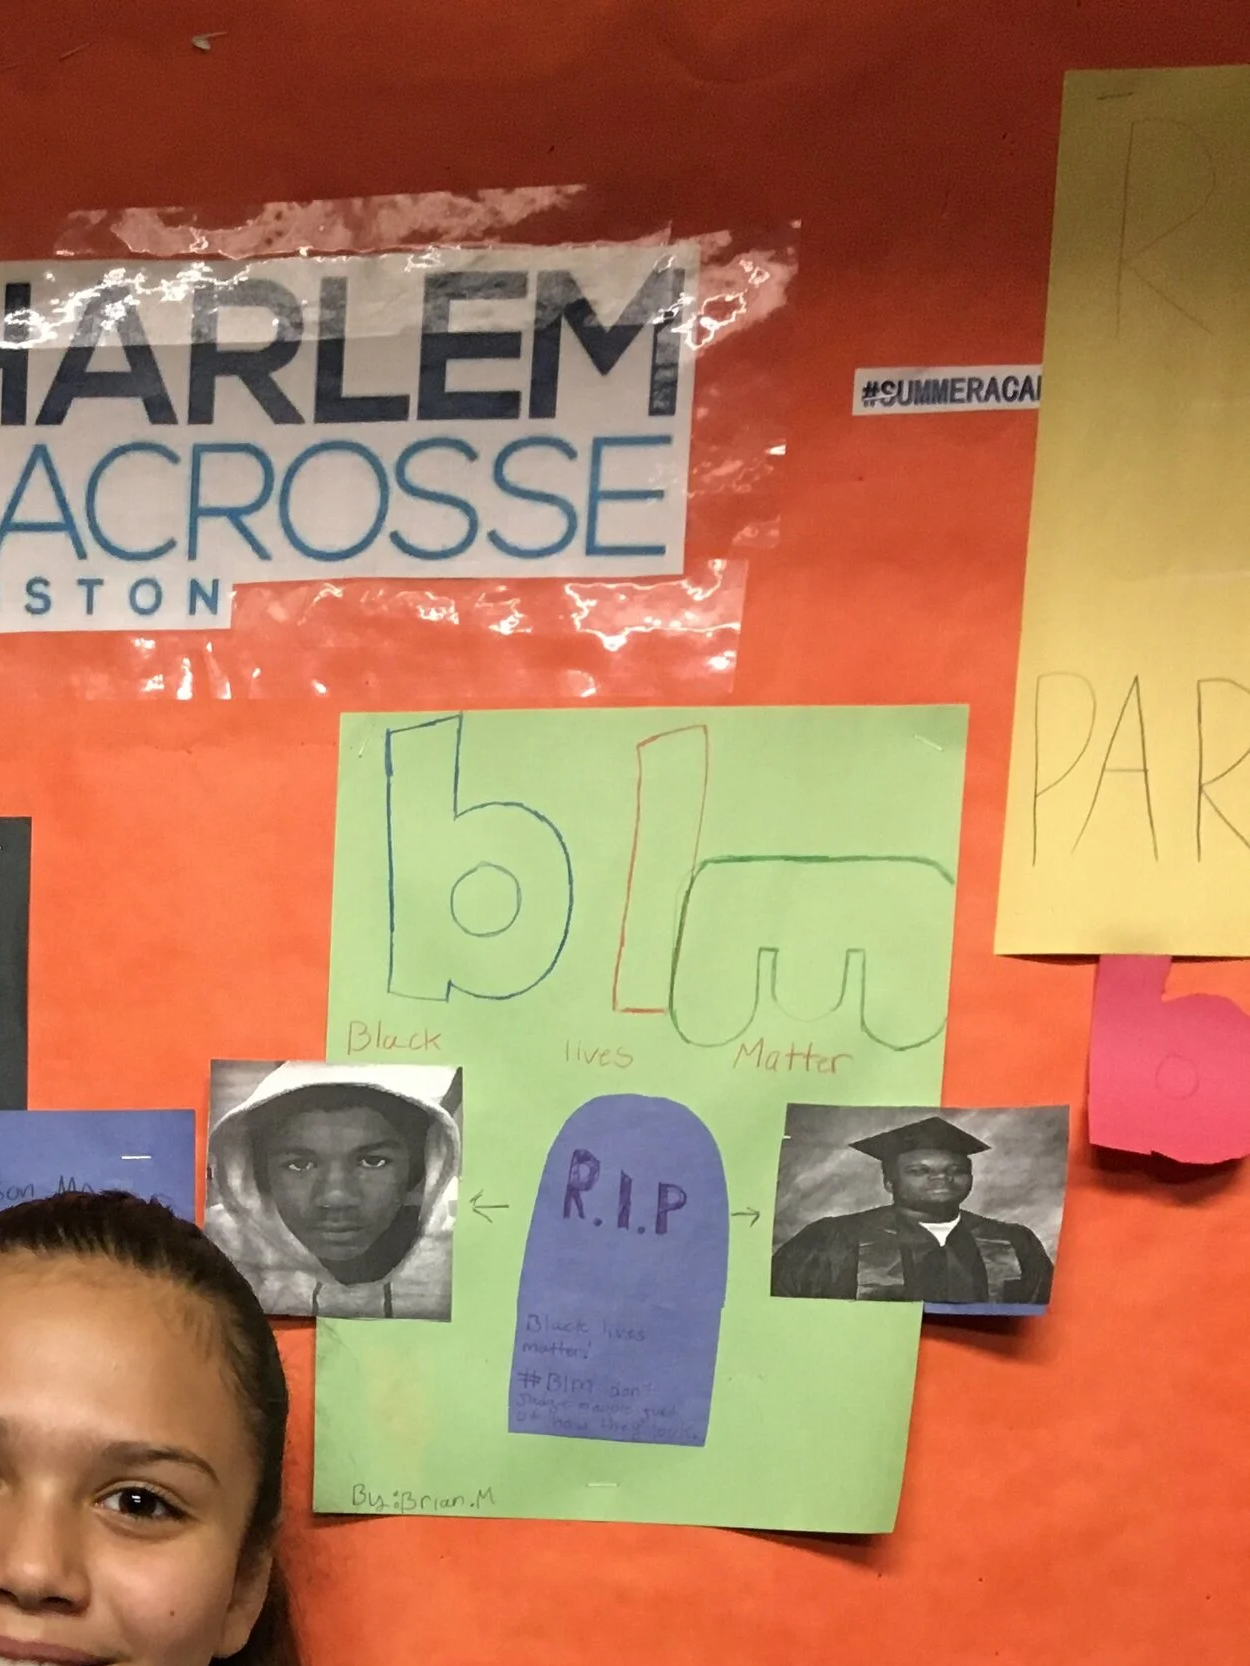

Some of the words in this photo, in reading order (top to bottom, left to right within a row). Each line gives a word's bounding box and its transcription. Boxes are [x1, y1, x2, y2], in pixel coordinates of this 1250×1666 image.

[346, 1019, 443, 1055] Black
[564, 1039, 635, 1069] lives
[732, 1038, 853, 1075] Matter
[562, 1147, 688, 1235] R.I.P
[525, 1312, 590, 1336] Black
